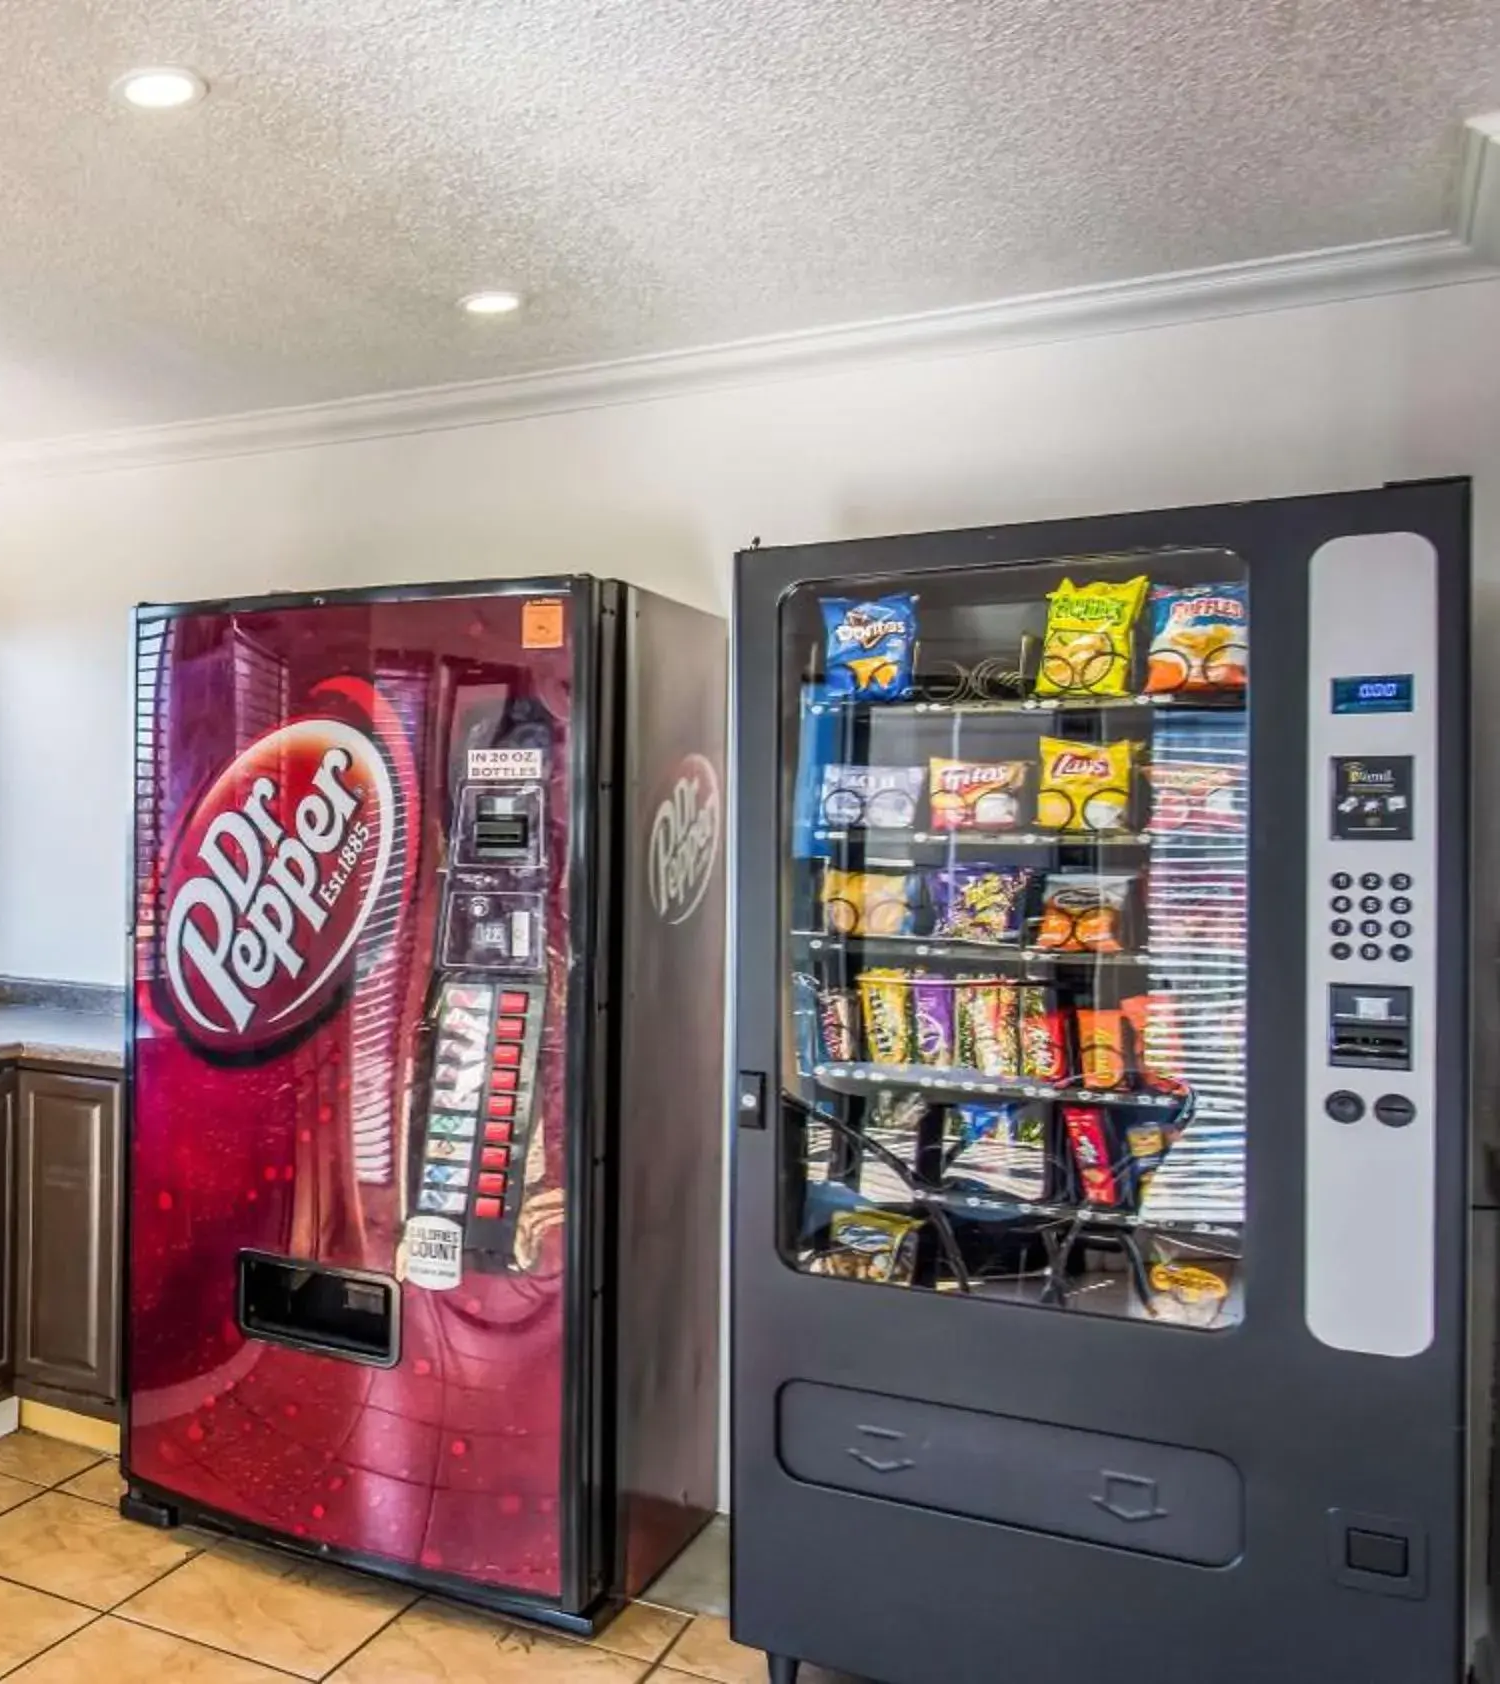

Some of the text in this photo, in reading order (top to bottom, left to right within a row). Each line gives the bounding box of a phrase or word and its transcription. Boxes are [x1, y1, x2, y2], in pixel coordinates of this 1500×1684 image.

[470, 752, 488, 763] IN
[490, 752, 509, 763] 20
[471, 766, 538, 778] BOTTLES
[198, 776, 284, 914] Dr
[166, 746, 360, 1034] Pepper
[410, 1240, 459, 1261] COUNT
